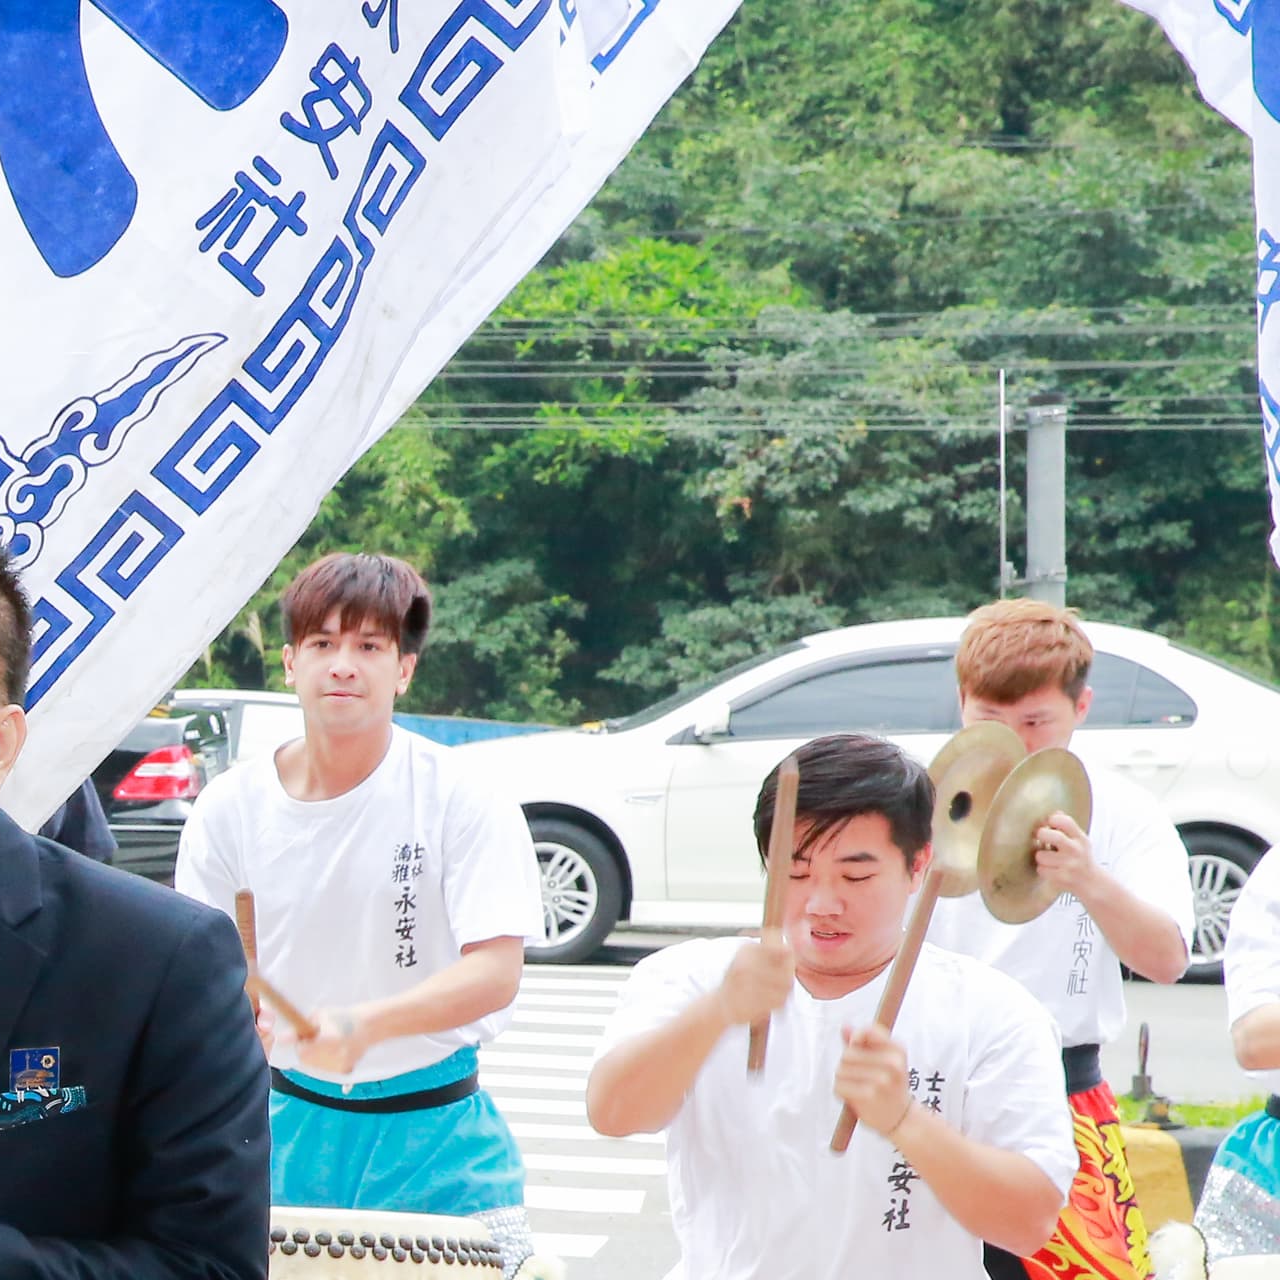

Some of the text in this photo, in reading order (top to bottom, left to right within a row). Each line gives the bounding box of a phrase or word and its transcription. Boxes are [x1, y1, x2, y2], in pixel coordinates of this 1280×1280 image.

[394, 886, 417, 968] 永安社
[882, 1149, 920, 1232] 安社
